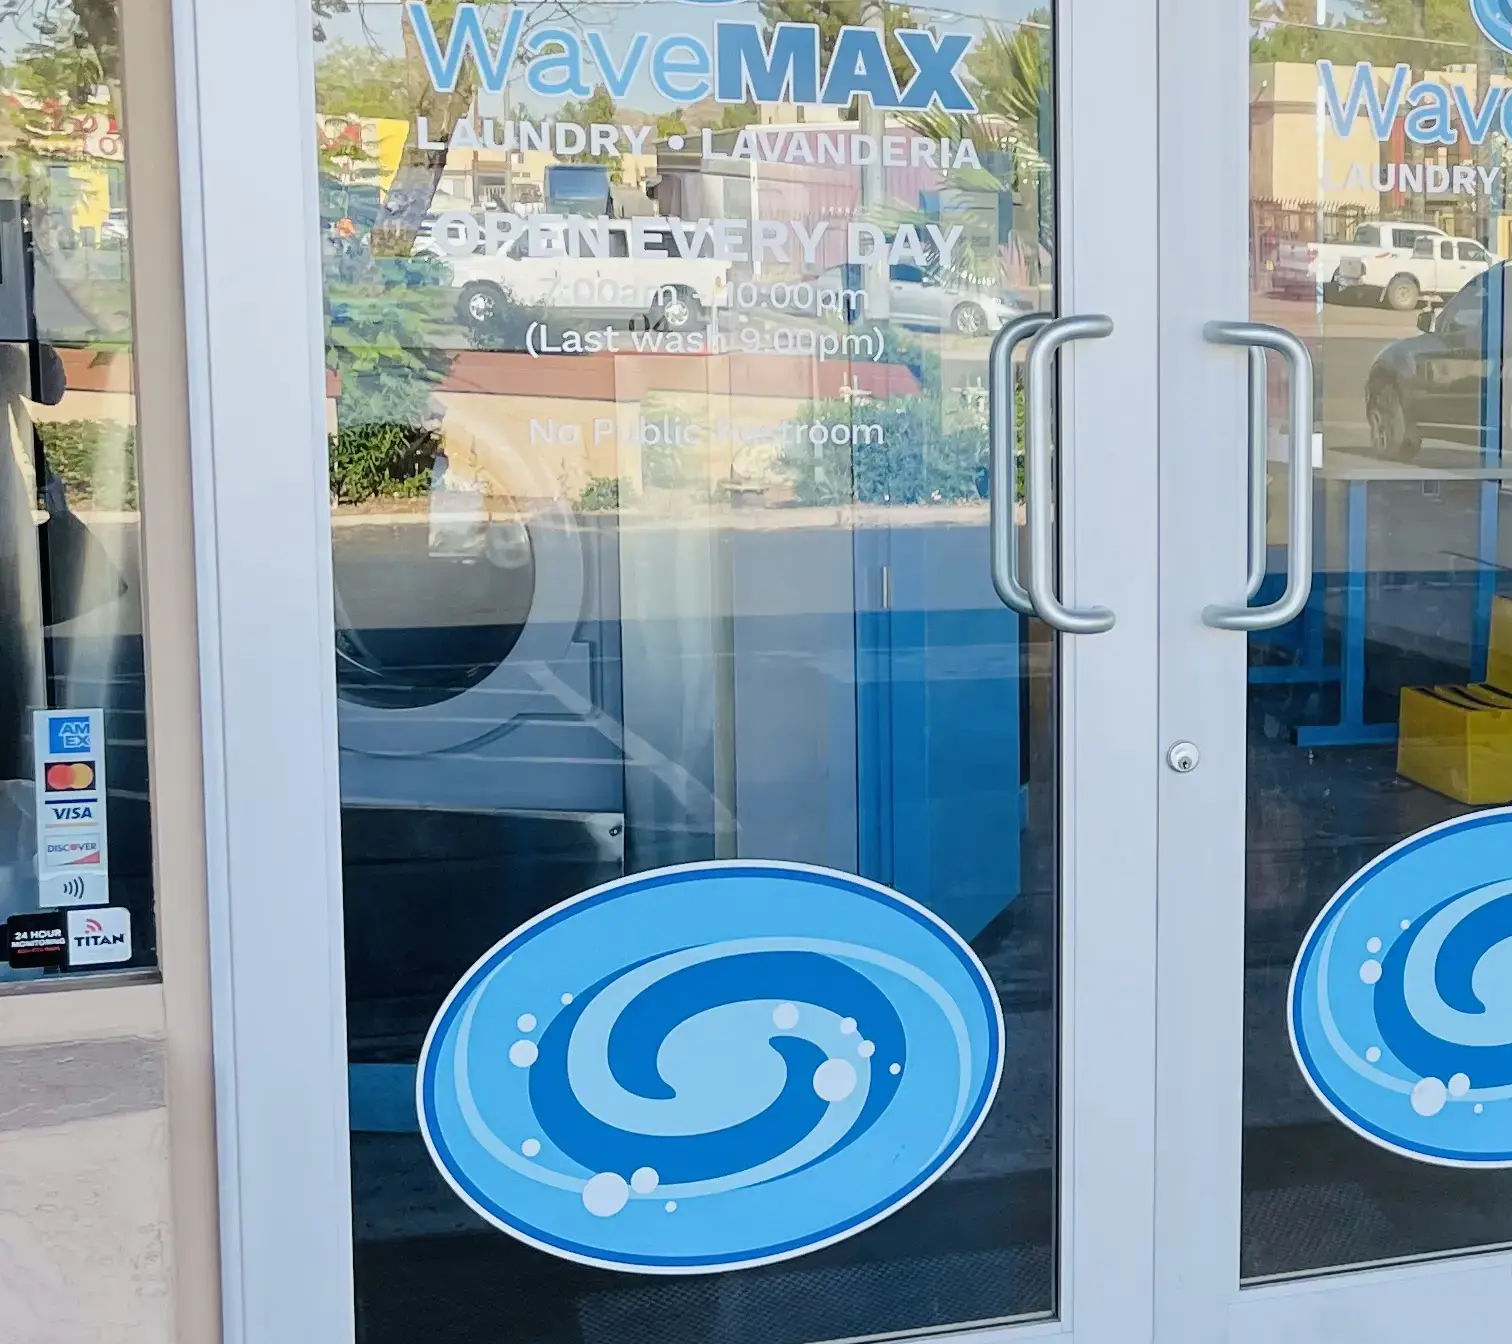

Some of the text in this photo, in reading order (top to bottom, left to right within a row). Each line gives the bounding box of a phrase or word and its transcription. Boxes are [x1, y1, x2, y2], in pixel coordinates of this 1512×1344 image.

[406, 0, 979, 116] WaveMAX
[417, 116, 982, 170] LAUNDRY LAVANDERIA
[1319, 162, 1500, 196] LAUNDRY
[432, 210, 965, 267] OPEN EVERY DAY
[724, 280, 869, 317] 10:00pm
[525, 320, 886, 362] (Last wash 9:00pm)
[529, 418, 581, 446] No
[594, 417, 702, 446] Public
[52, 807, 93, 820] VISA
[47, 842, 97, 853] DISCOVER
[14, 928, 62, 941] 24 HOUR
[74, 933, 125, 947] TITAN
